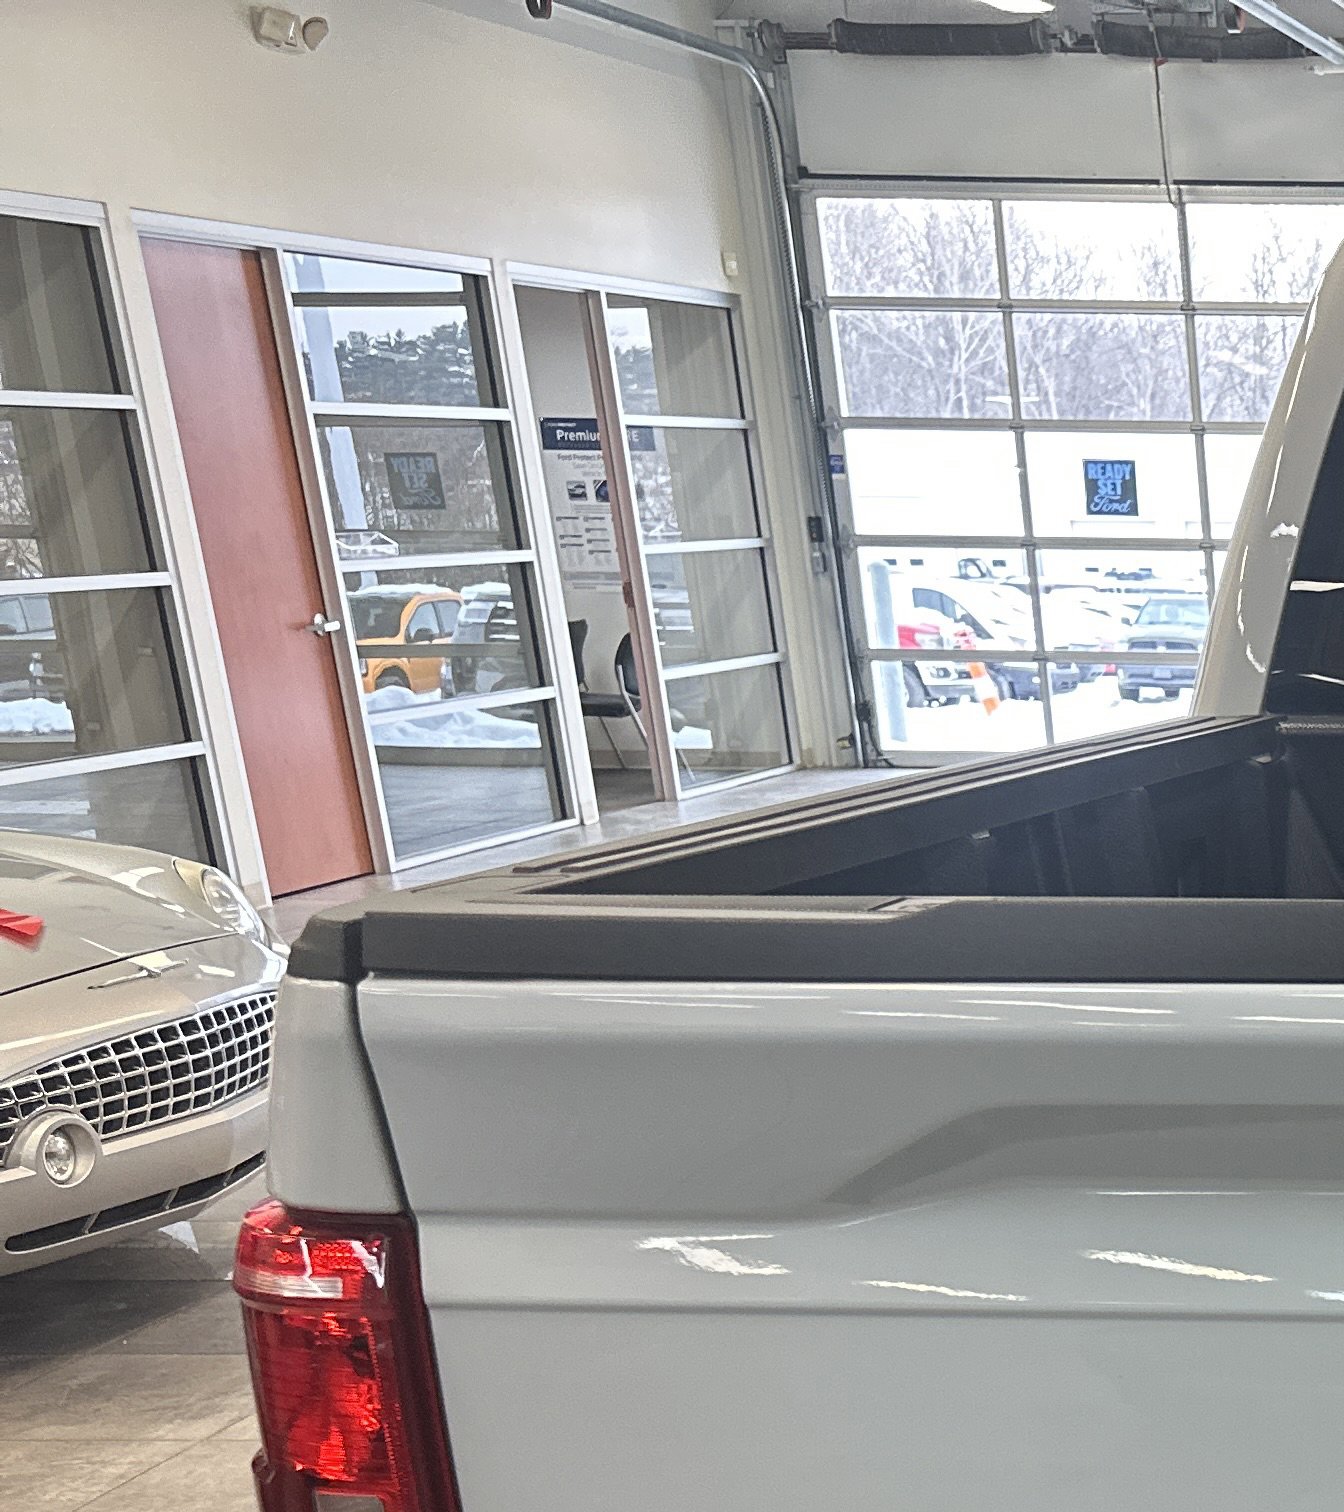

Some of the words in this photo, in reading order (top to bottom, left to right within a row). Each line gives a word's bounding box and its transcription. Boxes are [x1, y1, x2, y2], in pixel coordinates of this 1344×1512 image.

[1087, 463, 1132, 480] READY
[1097, 479, 1122, 496] SET
[1090, 495, 1132, 513] Ford
